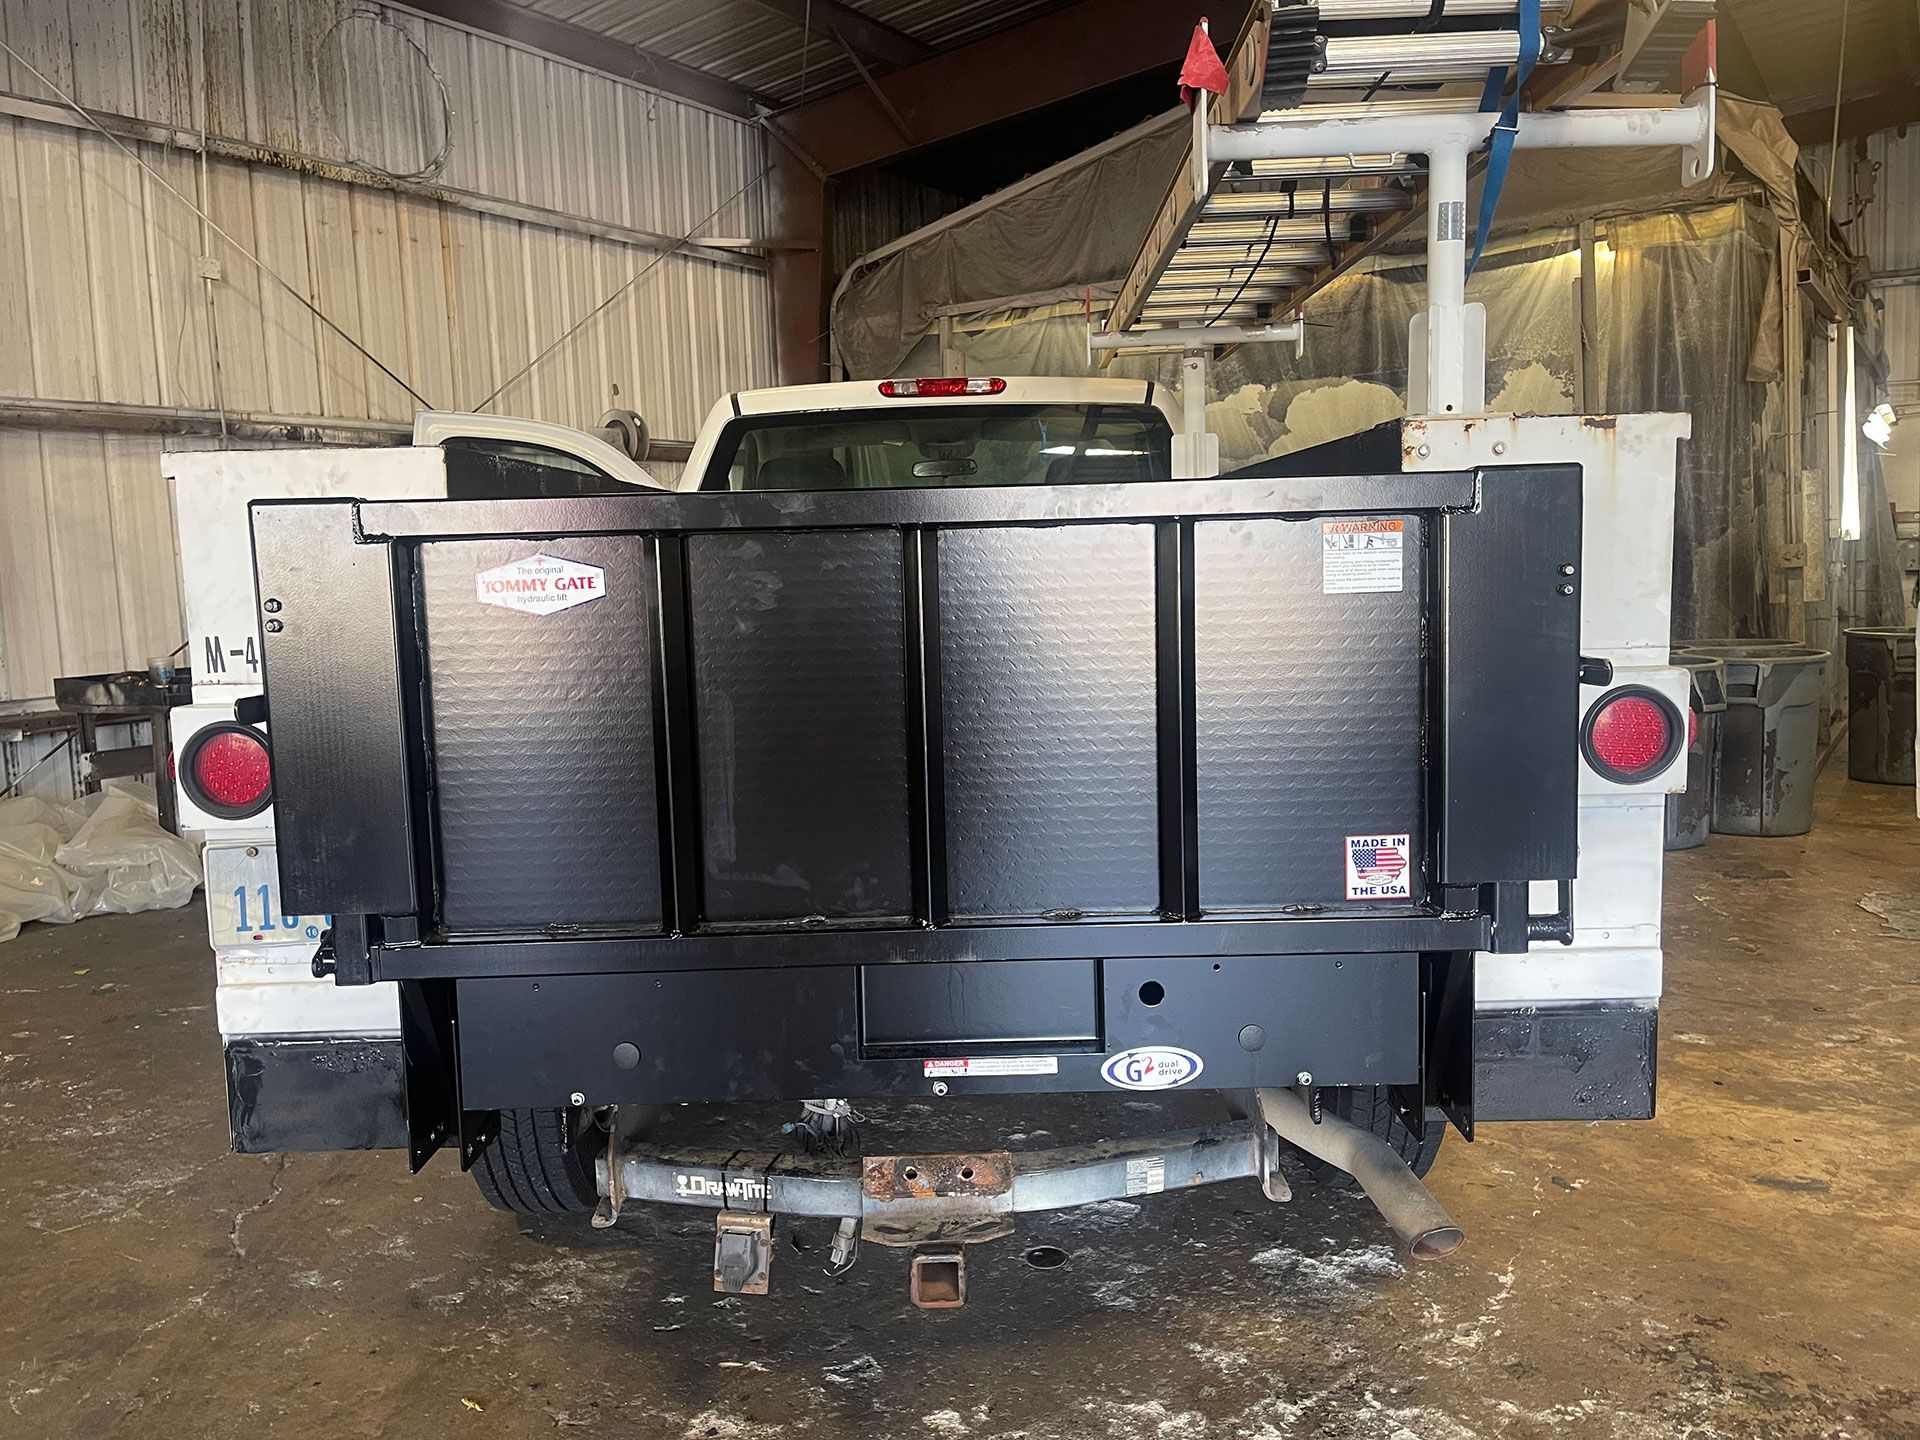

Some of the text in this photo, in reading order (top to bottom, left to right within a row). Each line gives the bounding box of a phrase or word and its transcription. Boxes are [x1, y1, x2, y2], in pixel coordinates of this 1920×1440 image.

[1341, 521, 1397, 533] WARNING
[516, 565, 564, 576] The original
[482, 578, 548, 594] TOMMY
[517, 594, 568, 604] hydraulic lift
[204, 635, 259, 674] M-4
[1350, 837, 1406, 848] MADE IN
[1352, 885, 1407, 896] THE USA
[234, 884, 299, 933] 11
[306, 928, 318, 937] 16
[934, 1059, 965, 1068] DANGER
[1158, 1060, 1179, 1068] dual
[1158, 1067, 1183, 1076] drive
